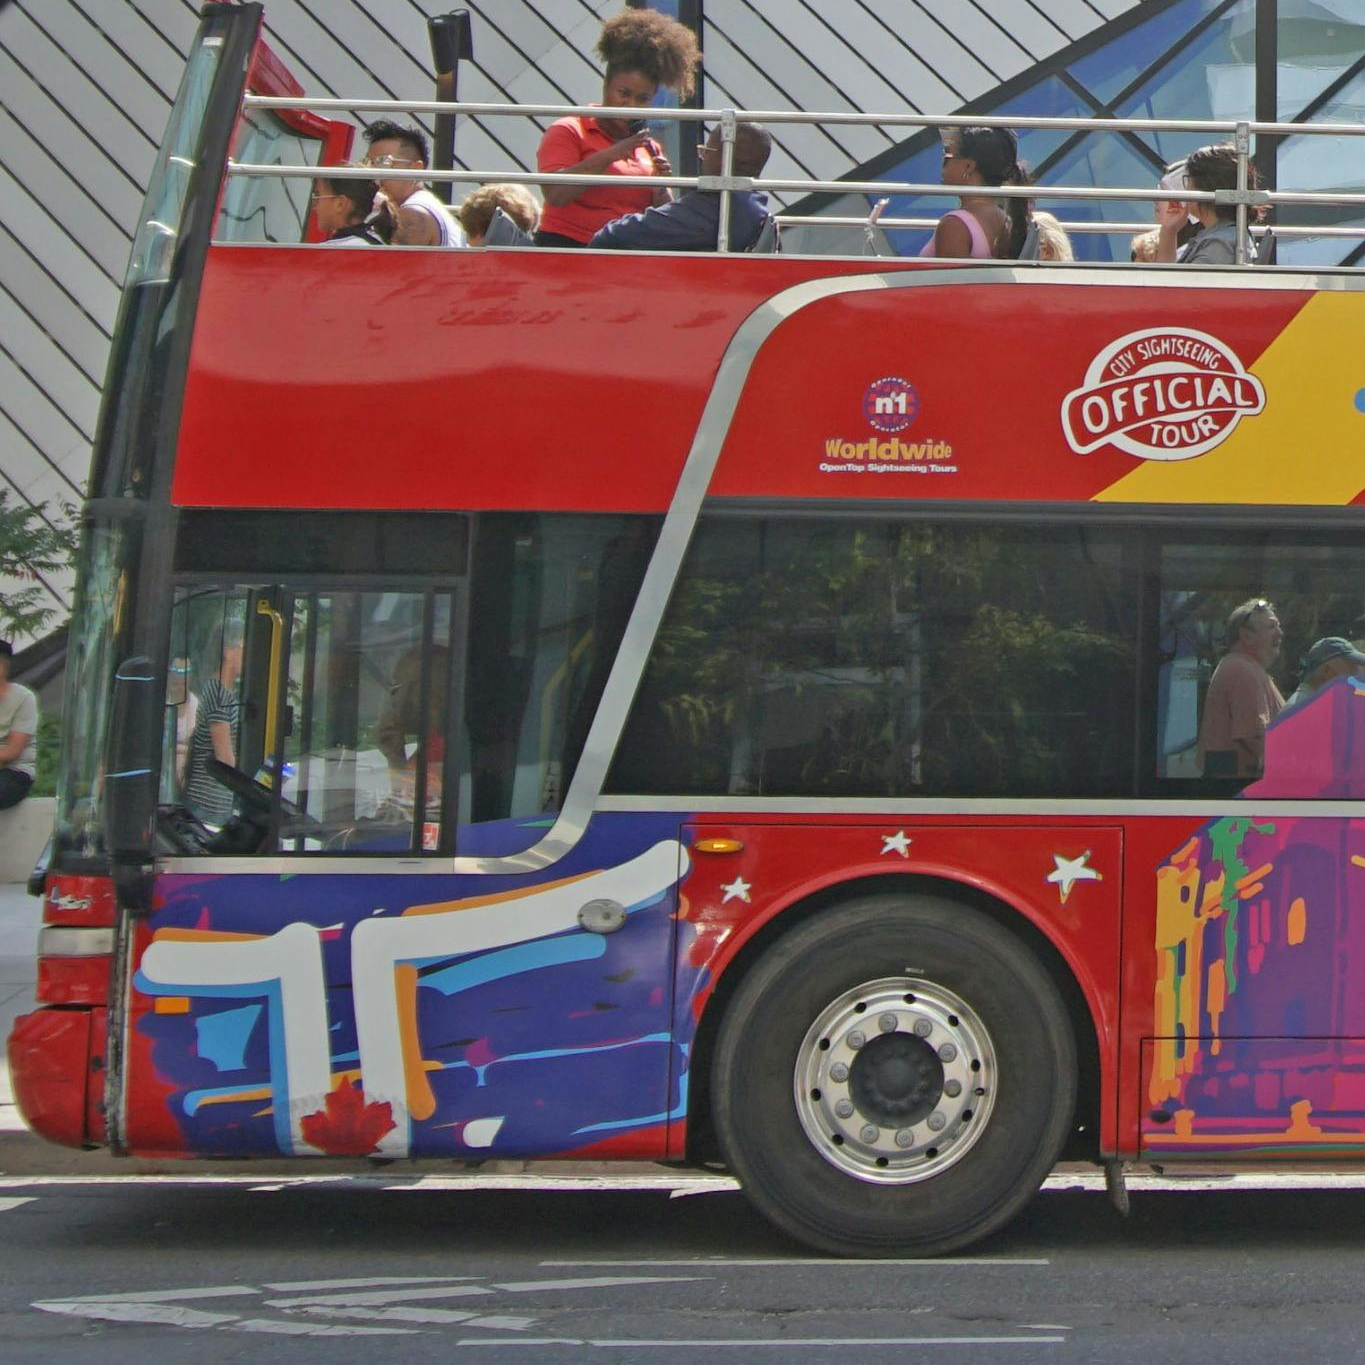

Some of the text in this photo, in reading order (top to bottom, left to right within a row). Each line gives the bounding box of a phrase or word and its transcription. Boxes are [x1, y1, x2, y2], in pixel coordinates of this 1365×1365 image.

[1110, 338, 1221, 376] CITY SIGHTSEEING
[1082, 378, 1253, 433] OFFICIAL
[1150, 415, 1219, 446] TOUR
[825, 438, 952, 460] Worldwide
[867, 463, 927, 474] Sightseeing
[929, 464, 957, 473] Tours
